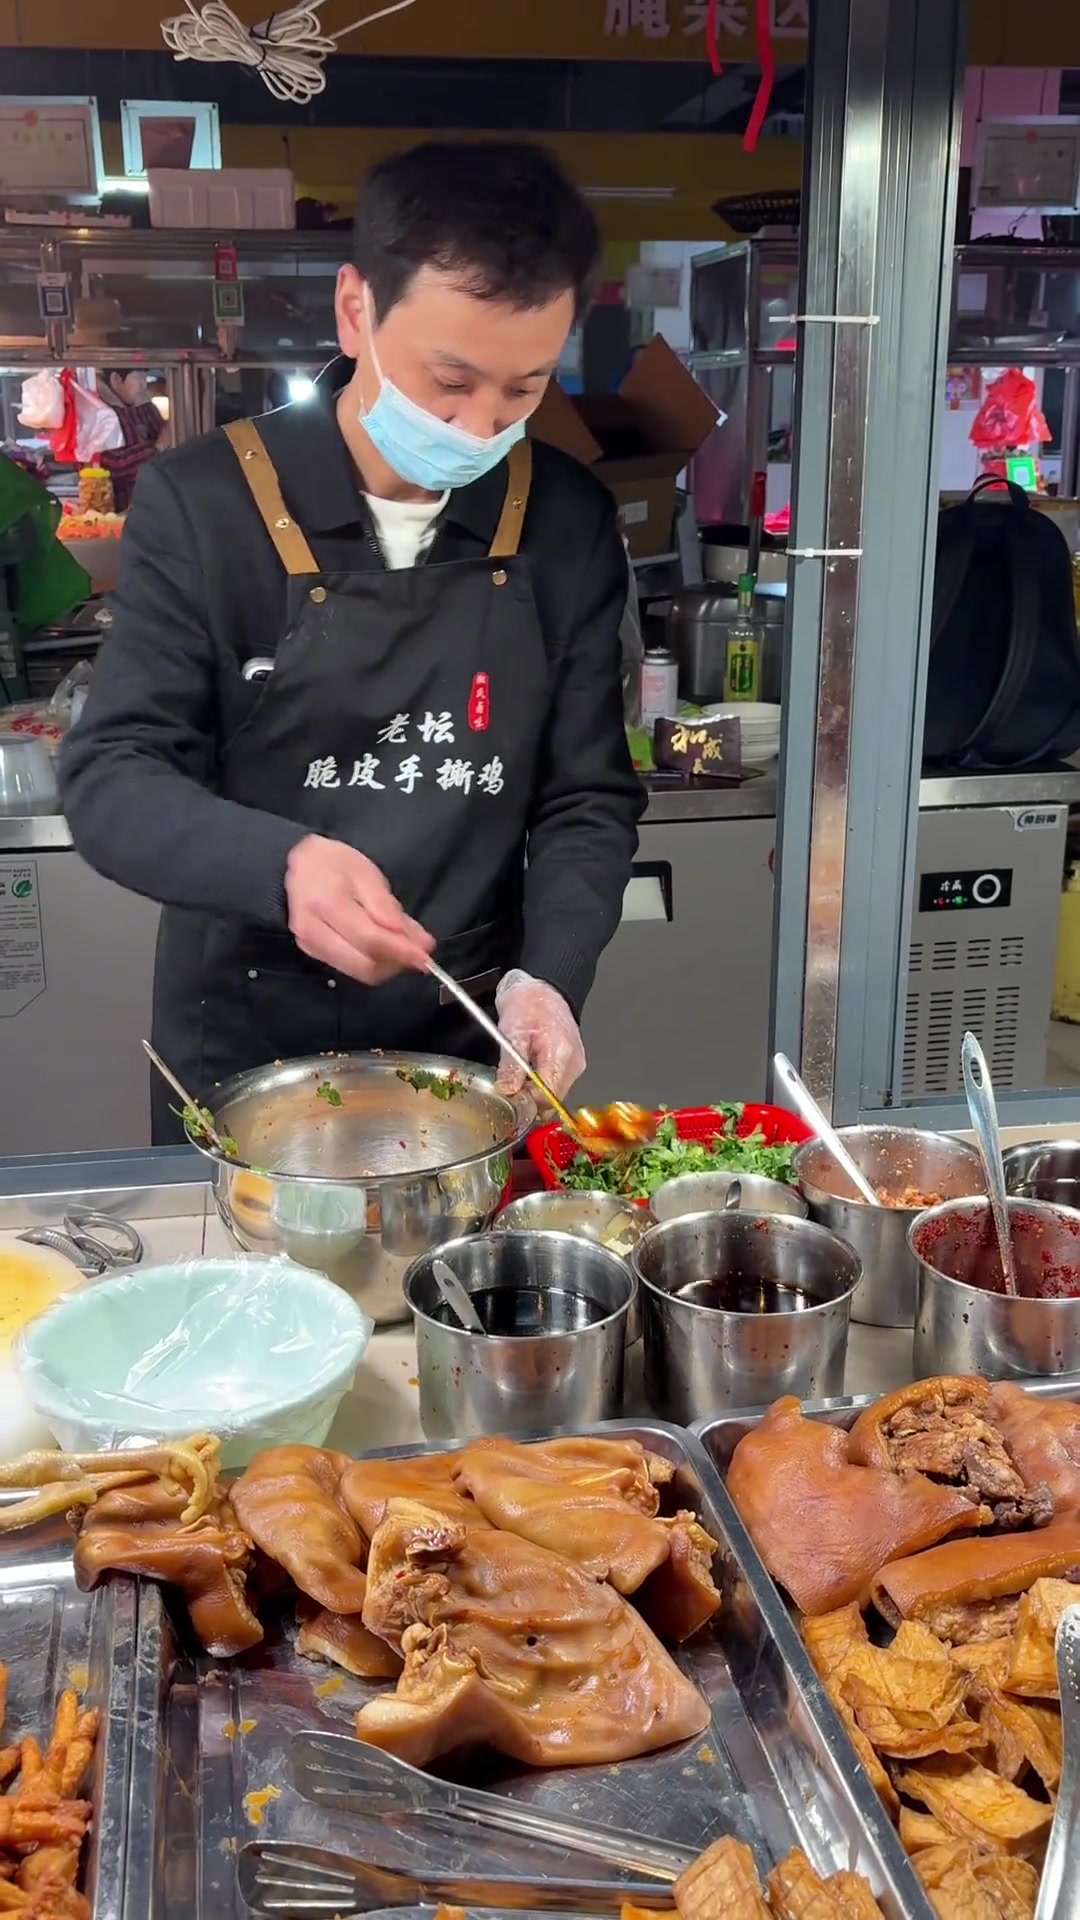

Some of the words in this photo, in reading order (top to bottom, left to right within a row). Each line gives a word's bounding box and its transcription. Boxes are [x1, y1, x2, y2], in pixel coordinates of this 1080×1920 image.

[376, 711, 456, 744] 老坛
[303, 752, 505, 796] 脆皮手撕鸡
